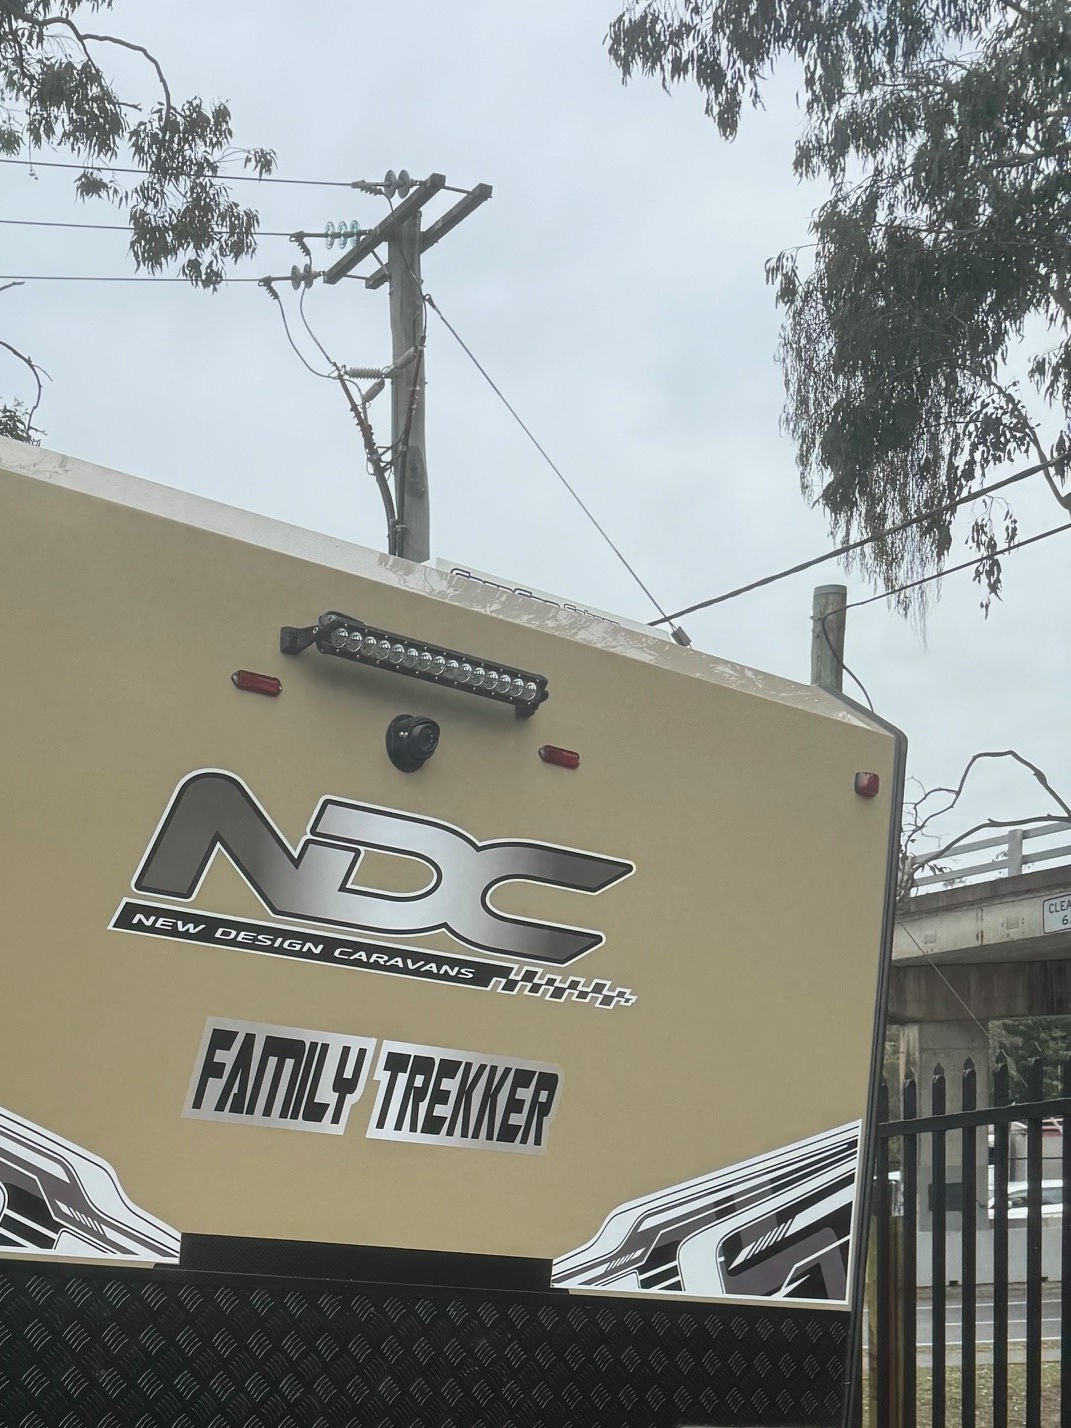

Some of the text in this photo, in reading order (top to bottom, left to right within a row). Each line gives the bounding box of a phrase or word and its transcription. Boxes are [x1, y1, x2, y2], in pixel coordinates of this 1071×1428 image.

[132, 769, 635, 965] NDC
[131, 912, 476, 979] NEW DESIGN CARAVANS
[192, 1028, 559, 1147] FAMILY TREKKER
